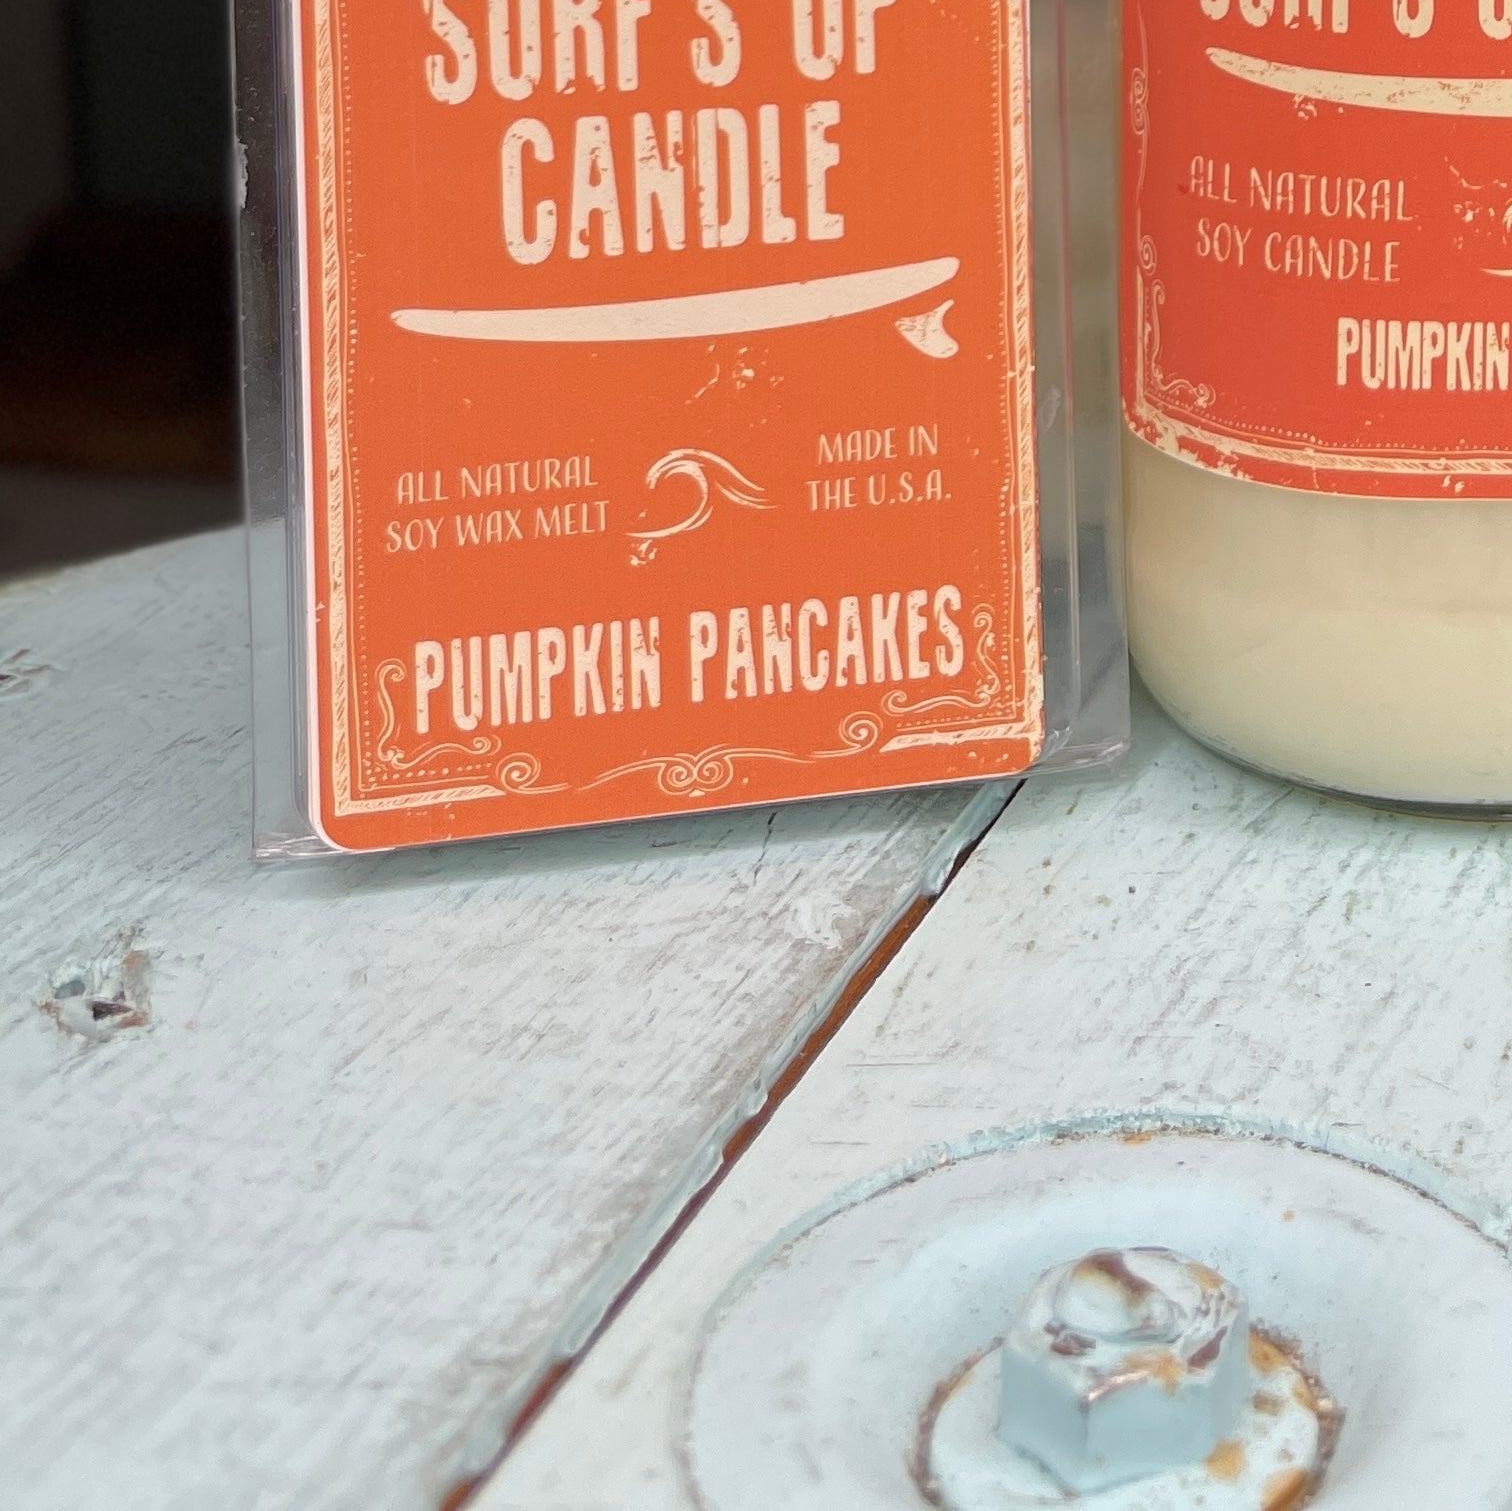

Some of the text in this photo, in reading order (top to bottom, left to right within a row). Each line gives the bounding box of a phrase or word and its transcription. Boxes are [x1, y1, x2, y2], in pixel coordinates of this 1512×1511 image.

[500, 100, 844, 265] CANDLE
[1188, 154, 1413, 222] ALL NATURAL
[1197, 218, 1400, 282] SOY CANDLE
[1336, 317, 1510, 392] PUMPKIN
[818, 423, 938, 464] MADE IN
[397, 455, 598, 505] ALL NATURAL
[806, 469, 952, 512] THE U.S.A.
[386, 500, 610, 553] SOY WAX MELT
[414, 584, 964, 735] PUMPKIN PANCAKES
